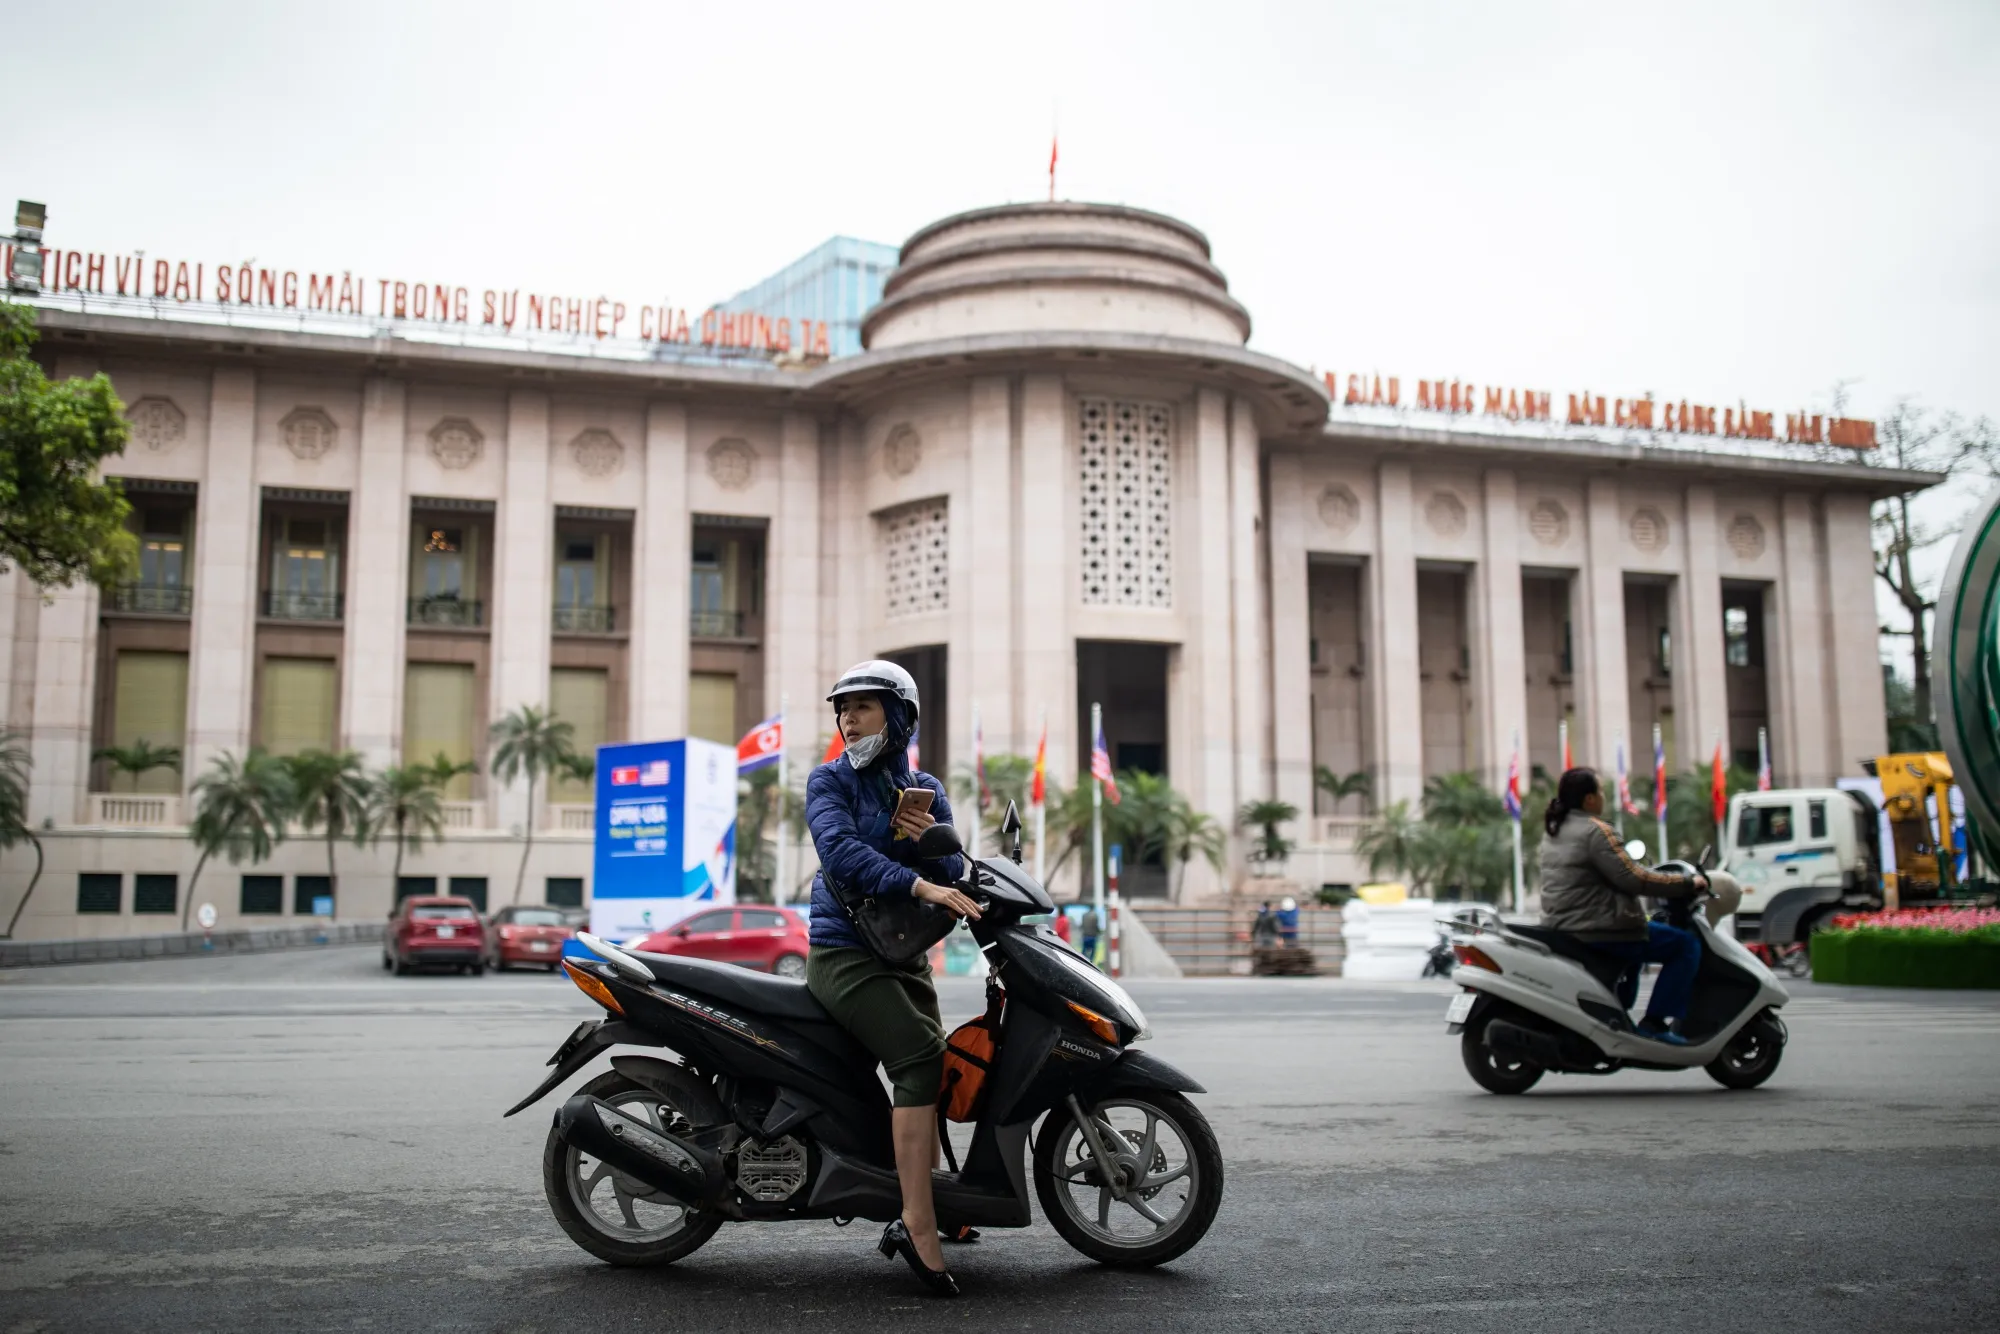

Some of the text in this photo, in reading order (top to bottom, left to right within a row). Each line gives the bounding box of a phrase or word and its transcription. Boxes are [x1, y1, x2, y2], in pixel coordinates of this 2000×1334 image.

[155, 259, 202, 302] ĐẠI
[217, 257, 298, 306] SỐNG
[379, 279, 468, 323] TRONG
[484, 288, 519, 334] SỰ
[527, 293, 626, 341] NGHIỆP
[800, 317, 831, 357] TA
[1061, 1040, 1101, 1060] HONDA
